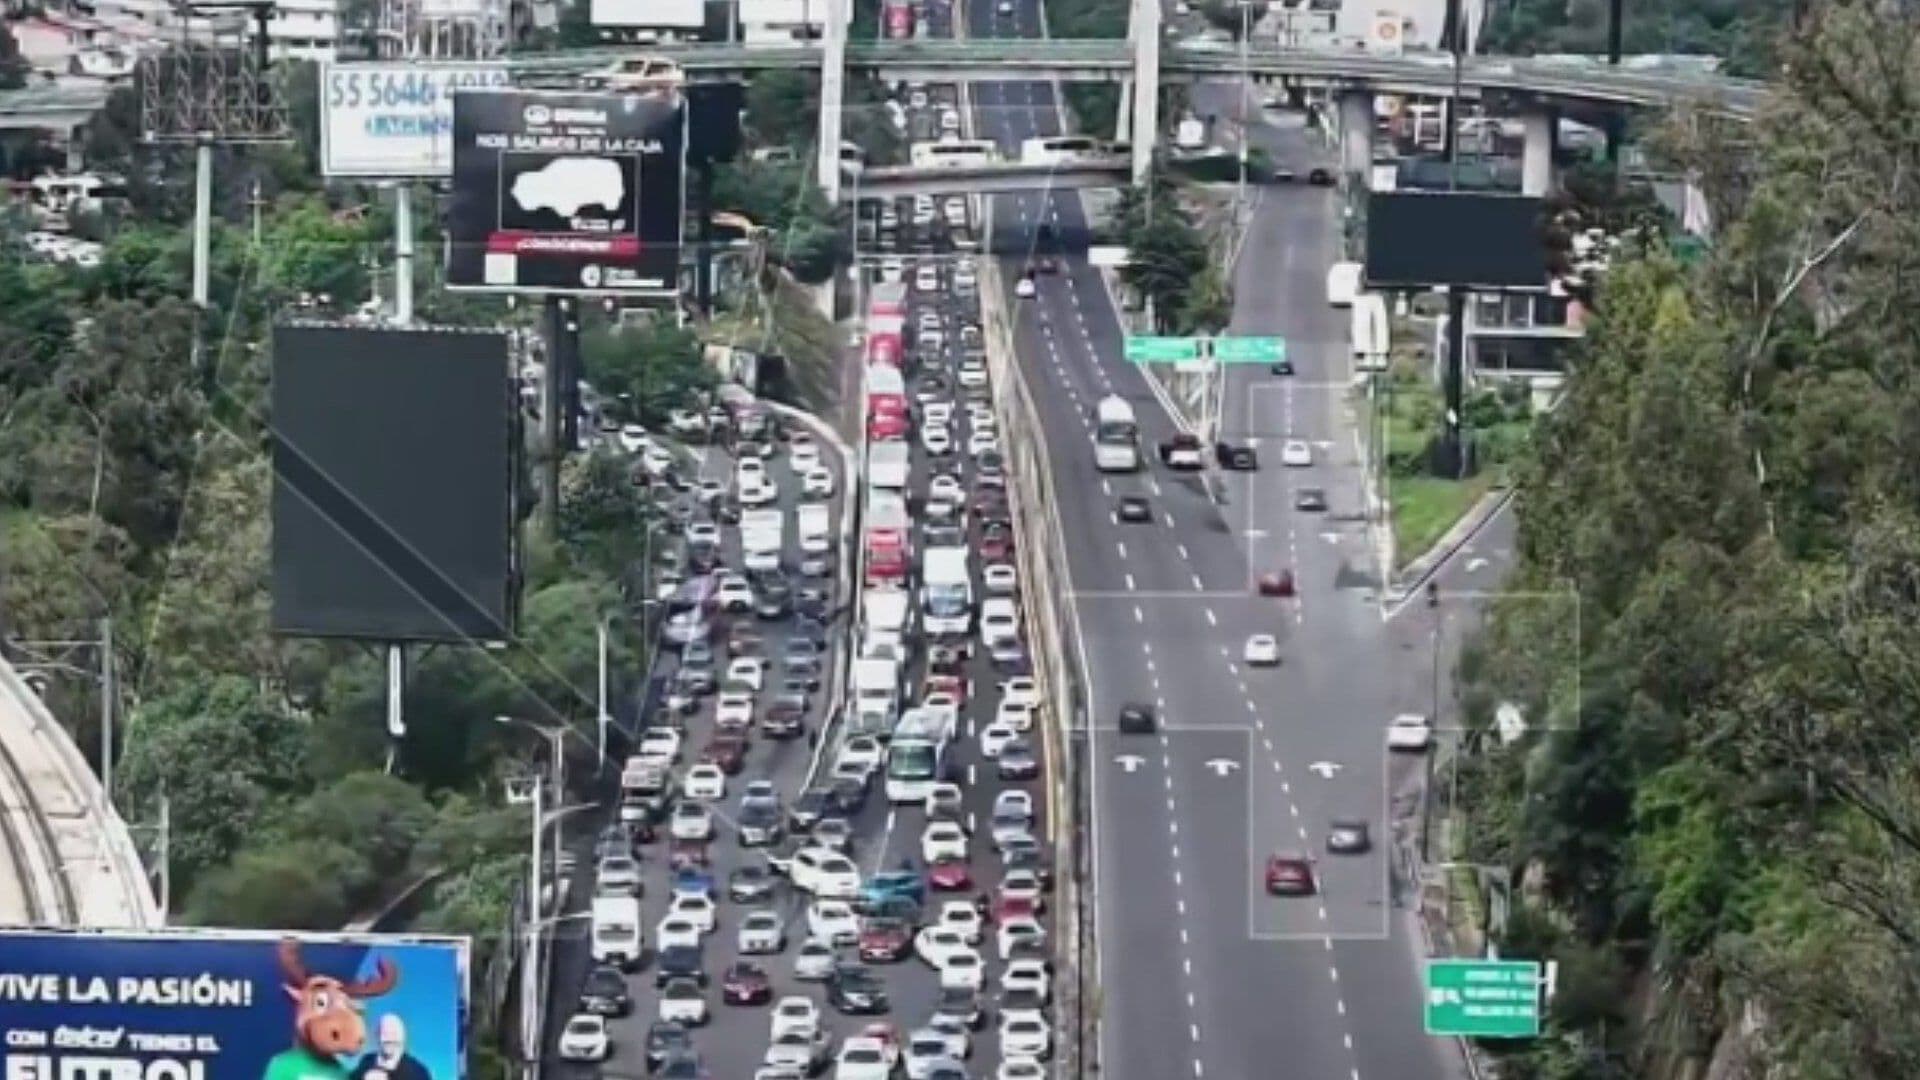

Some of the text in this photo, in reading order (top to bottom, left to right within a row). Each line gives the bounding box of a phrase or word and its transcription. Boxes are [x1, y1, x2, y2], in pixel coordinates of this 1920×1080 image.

[328, 72, 361, 107] 55
[605, 137, 623, 151] LA
[69, 976, 111, 1003] LA
[118, 971, 253, 1006] PASIÓN!
